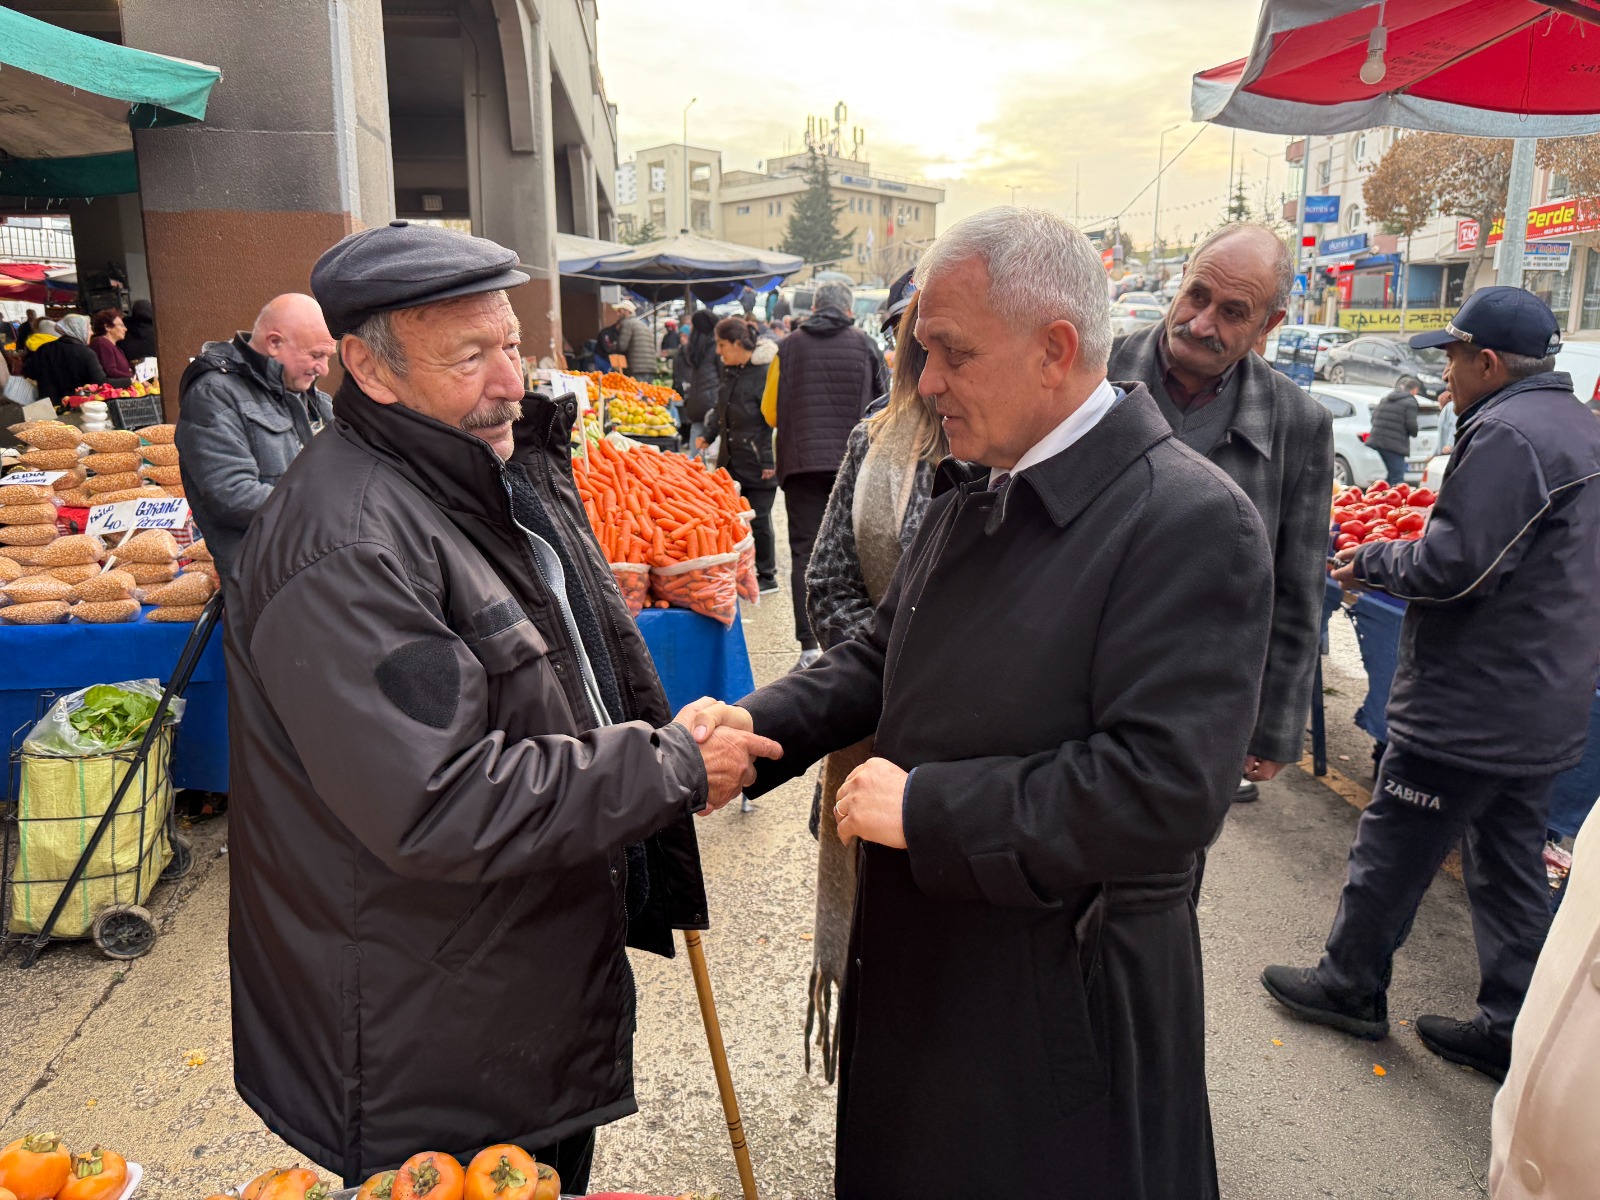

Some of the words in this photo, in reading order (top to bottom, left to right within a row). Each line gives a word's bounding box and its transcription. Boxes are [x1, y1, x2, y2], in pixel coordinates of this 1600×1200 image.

[1528, 205, 1575, 228] Perde
[1350, 313, 1401, 325] TALHA
[1408, 313, 1454, 324] PERD
[1384, 779, 1440, 810] ZABITA
